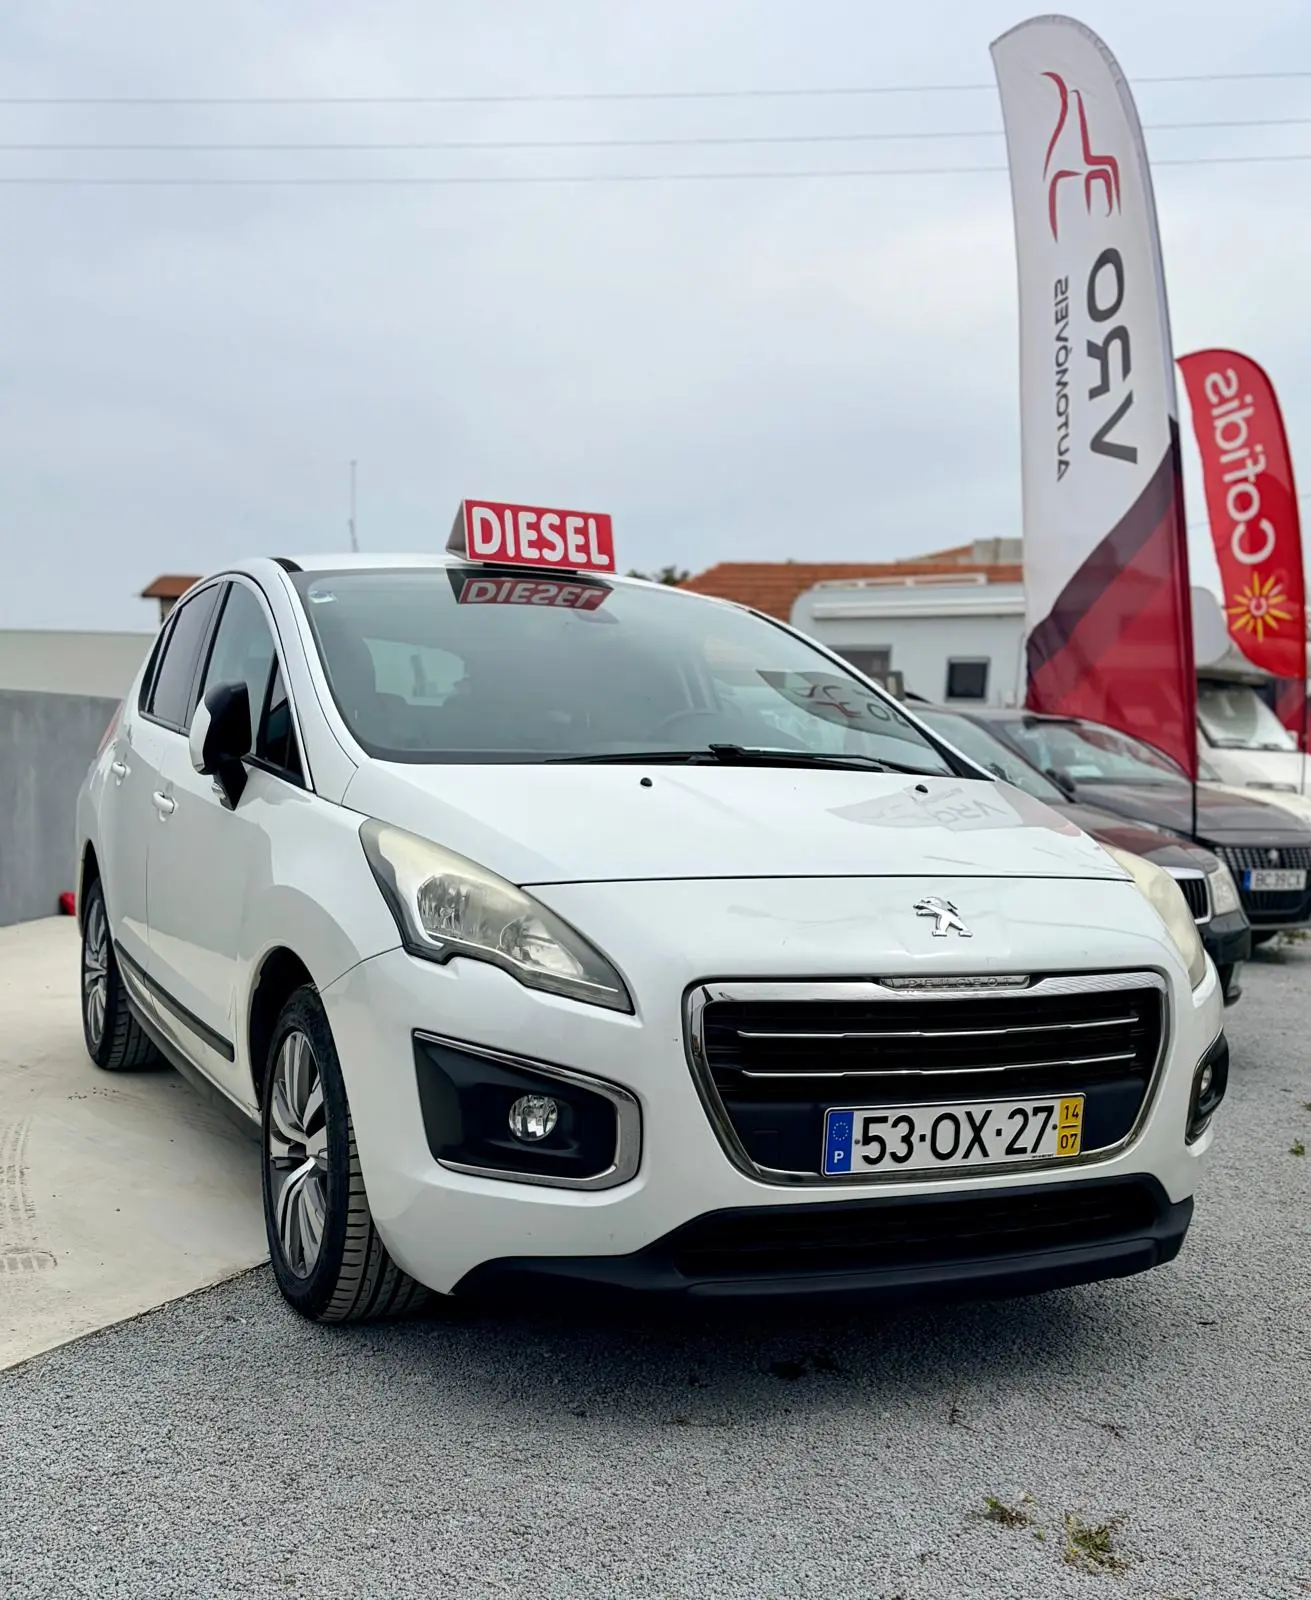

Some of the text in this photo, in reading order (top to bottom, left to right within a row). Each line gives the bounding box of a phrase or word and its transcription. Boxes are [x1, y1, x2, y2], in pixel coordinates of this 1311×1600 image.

[471, 506, 610, 566] DIESEL
[1063, 1103, 1080, 1120] 14
[1060, 1132, 1079, 1150] 07
[833, 1150, 845, 1164] P
